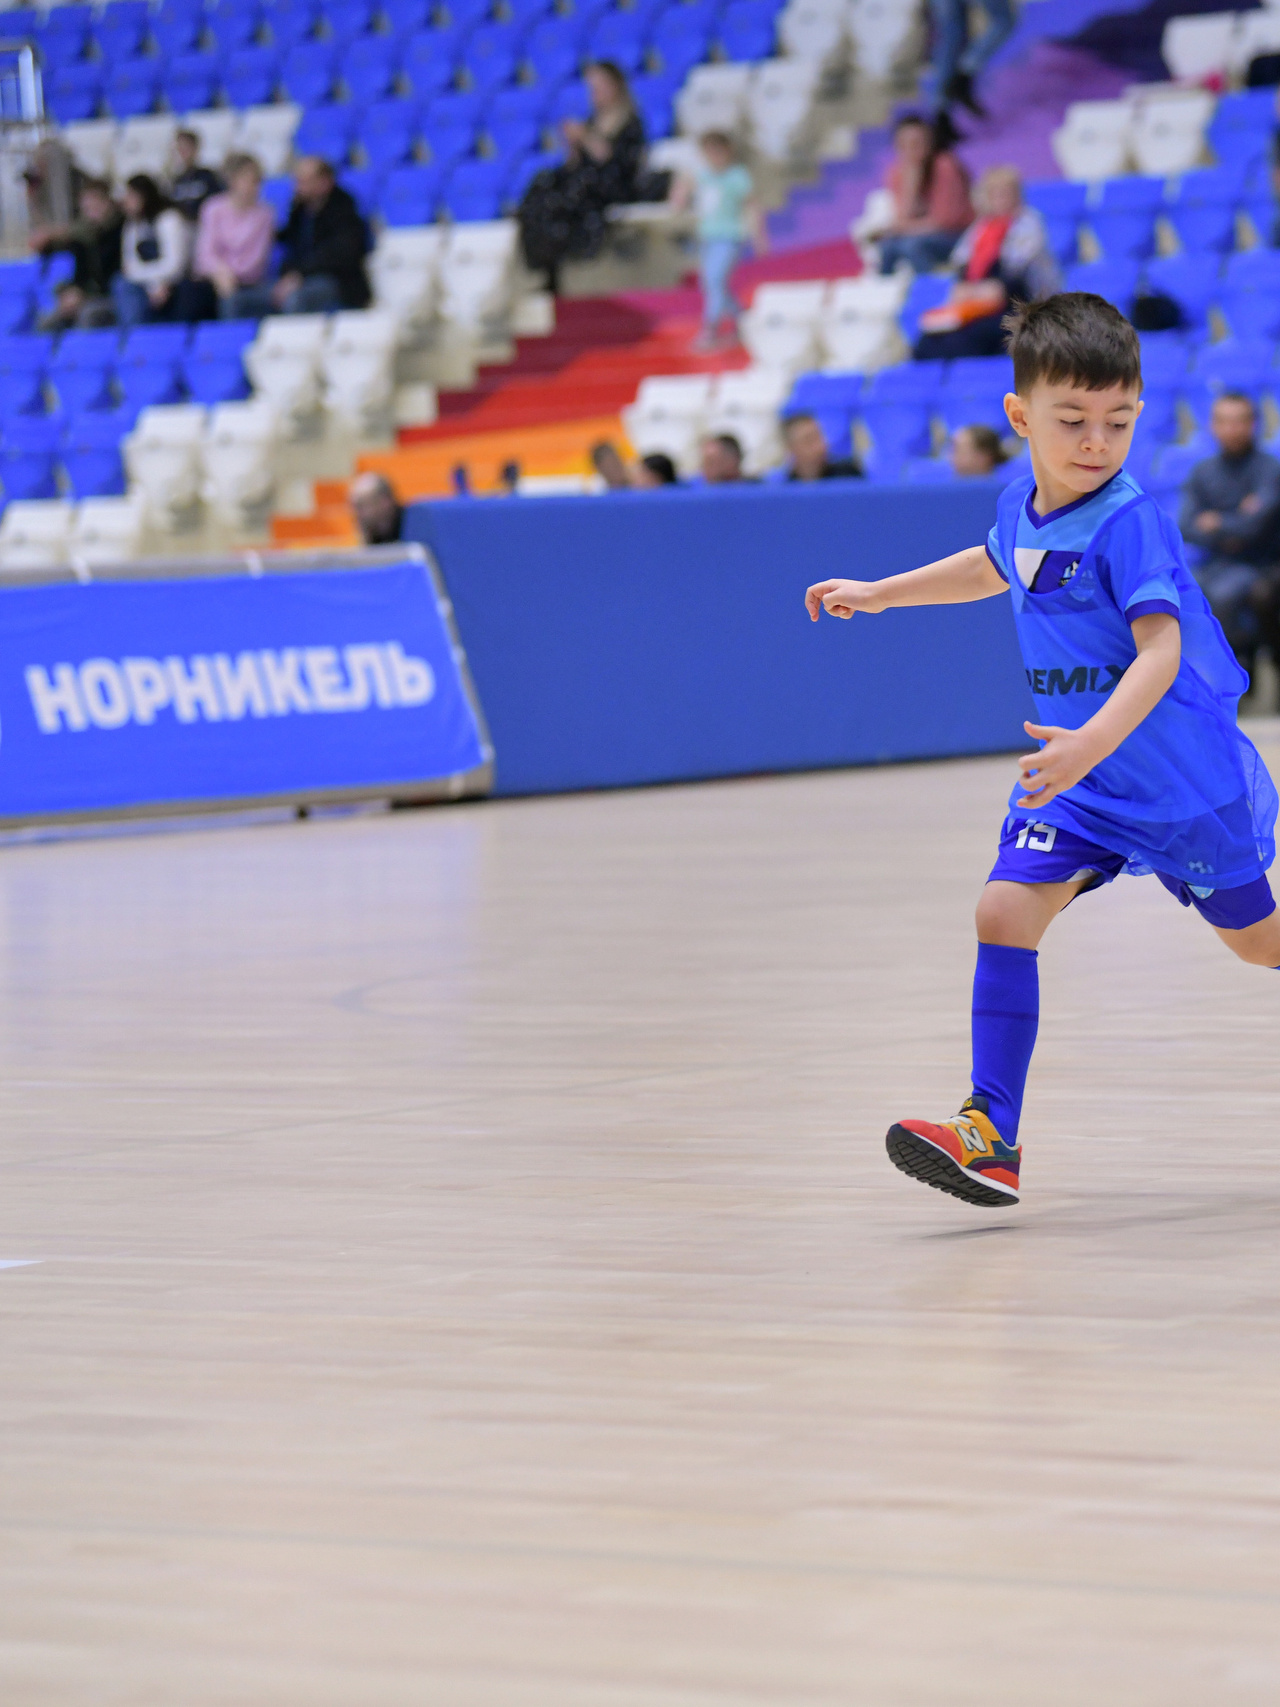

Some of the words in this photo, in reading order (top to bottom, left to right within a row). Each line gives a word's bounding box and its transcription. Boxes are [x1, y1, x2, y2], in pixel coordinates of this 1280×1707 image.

[25, 641, 436, 735] НОРНИКЕЛЬ
[1026, 664, 1126, 697] EMIX
[955, 1126, 988, 1153] N
